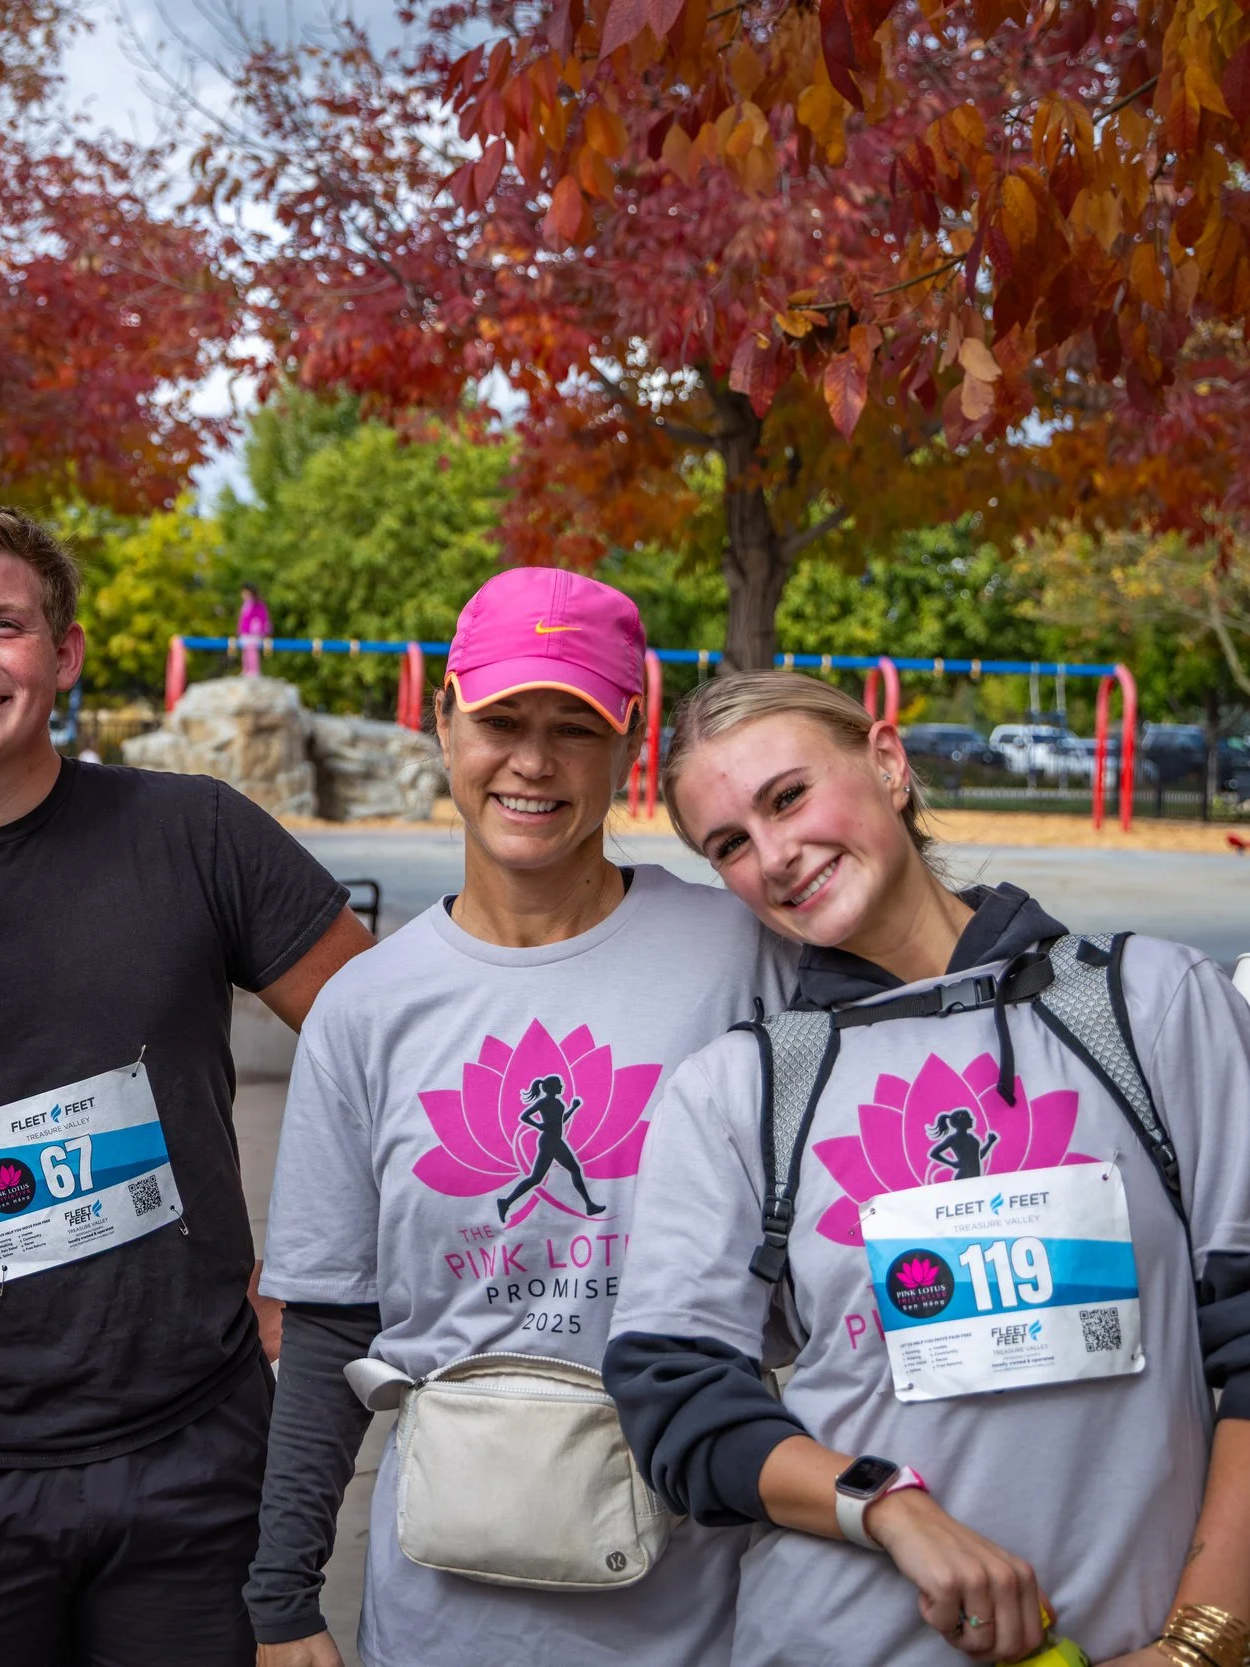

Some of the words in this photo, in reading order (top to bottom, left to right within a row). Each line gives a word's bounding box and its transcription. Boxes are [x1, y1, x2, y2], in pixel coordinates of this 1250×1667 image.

[11, 1112, 47, 1132] FLEET
[65, 1097, 95, 1116] FEET
[26, 1124, 62, 1142] TREASURE
[63, 1116, 90, 1130] VALLEY
[40, 1134, 94, 1198] 67
[8, 1183, 30, 1194] LOTUS
[64, 1204, 91, 1220] FLEET
[936, 1200, 984, 1220] FLEET
[1009, 1192, 1049, 1208] FEET
[68, 1223, 91, 1234] TREASURE
[91, 1218, 108, 1226] VALLEY
[69, 1213, 91, 1226] FEET
[954, 1220, 1002, 1233] TREASURE
[1006, 1214, 1040, 1226] VALLEY
[458, 1224, 494, 1243] THE
[444, 1243, 527, 1280] PINK
[546, 1234, 629, 1269] LOT
[958, 1236, 1053, 1312] 119
[486, 1276, 618, 1304] PROMISE
[896, 1289, 916, 1298] PINK
[918, 1285, 945, 1294] LOTUS
[522, 1313, 581, 1334] 2025
[991, 1324, 1028, 1337] FLEET
[997, 1334, 1026, 1346] FEET
